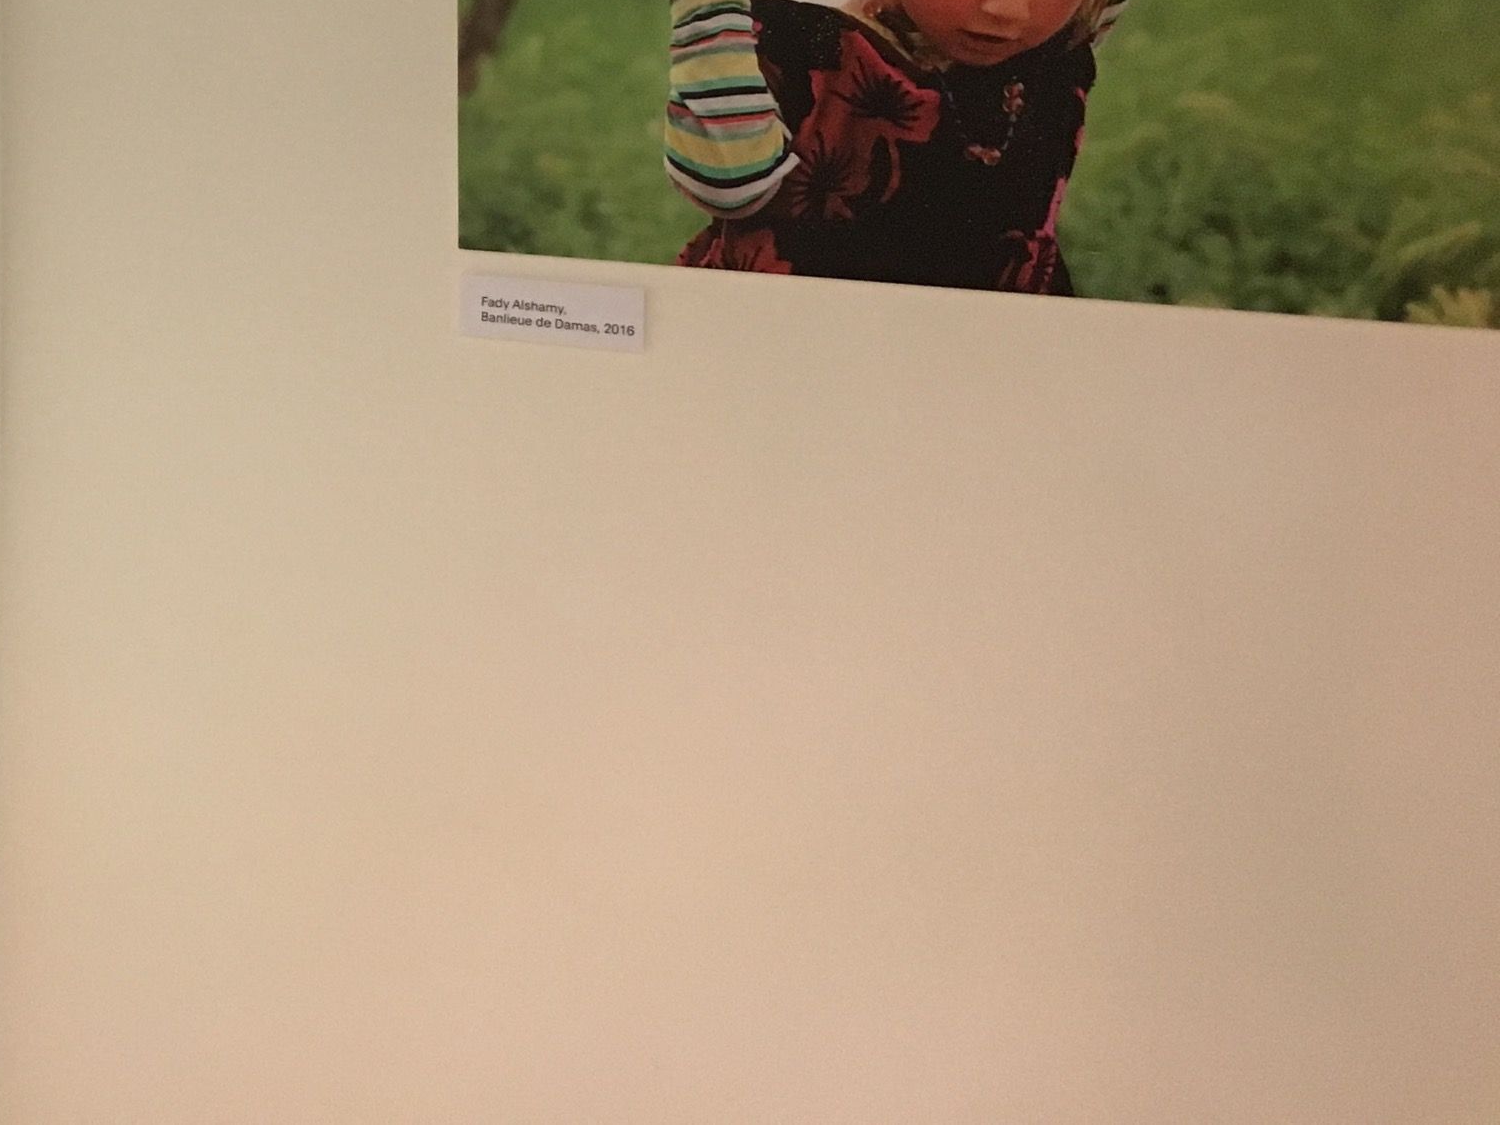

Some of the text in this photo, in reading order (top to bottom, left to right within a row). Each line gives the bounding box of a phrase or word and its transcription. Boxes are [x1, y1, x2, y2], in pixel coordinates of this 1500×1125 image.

[481, 296, 510, 311] Fady
[481, 311, 635, 337] Banlieue de Damas, 2016
